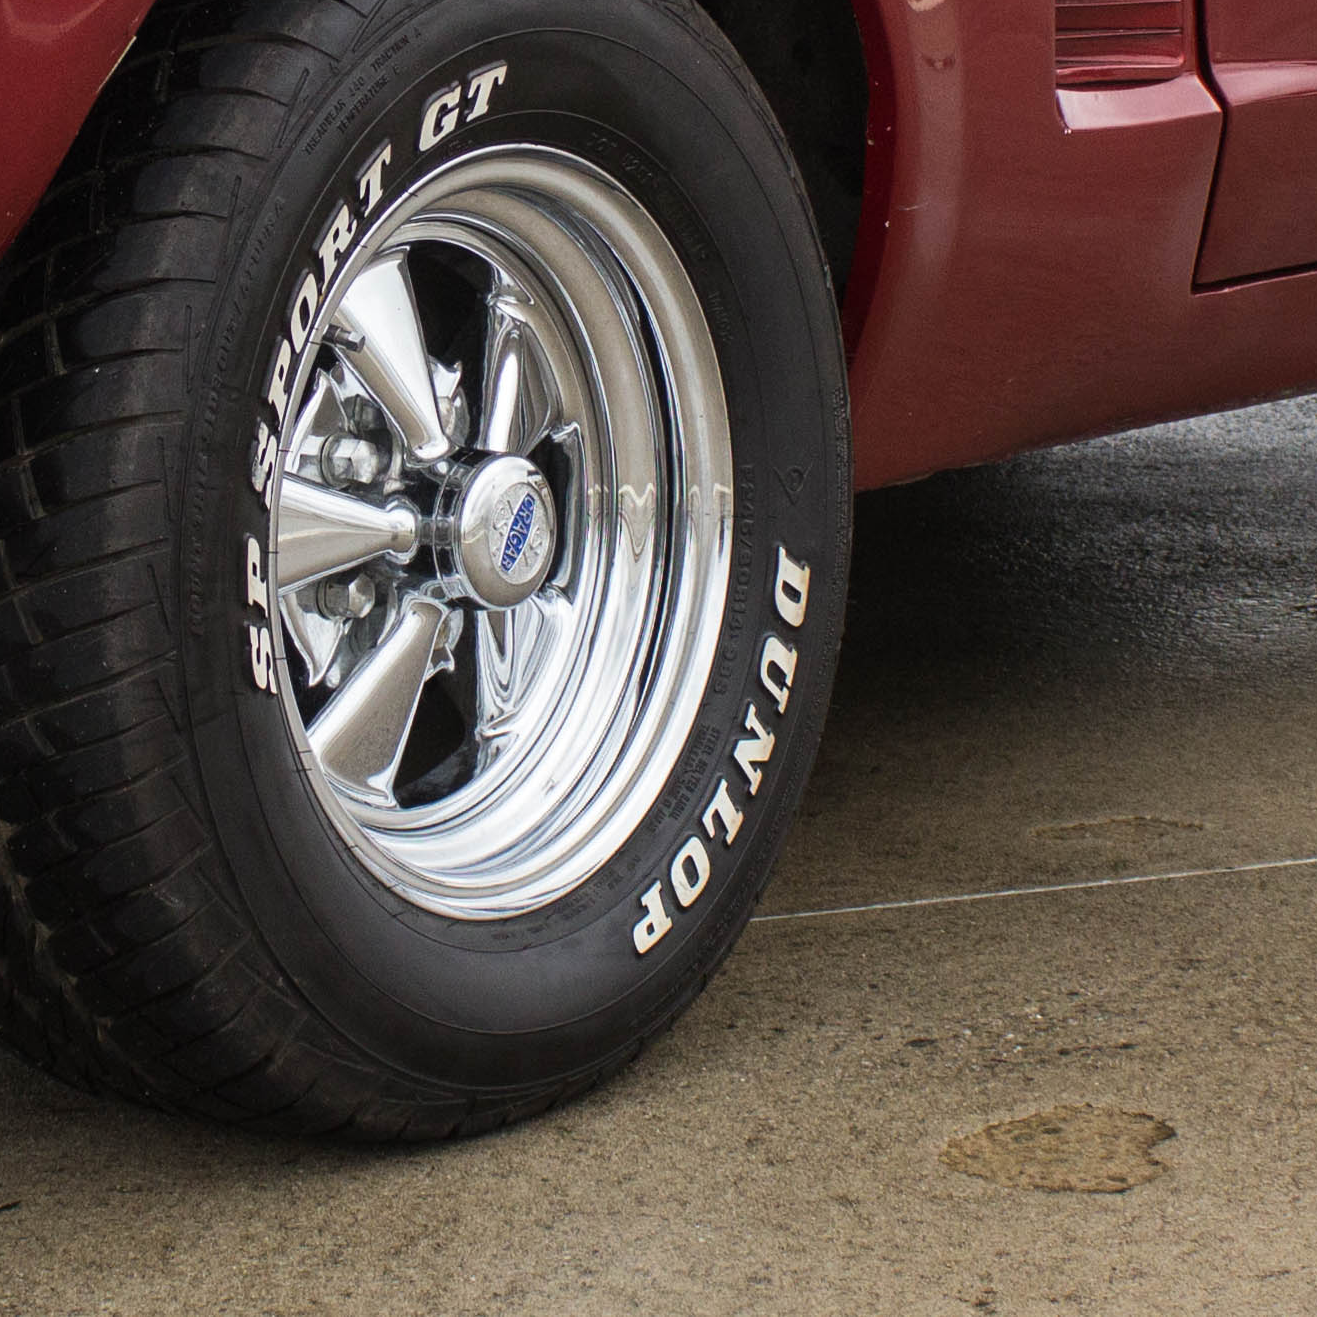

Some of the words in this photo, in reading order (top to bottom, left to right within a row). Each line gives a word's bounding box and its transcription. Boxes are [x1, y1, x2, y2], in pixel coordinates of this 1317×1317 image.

[419, 61, 507, 152] GT
[252, 141, 392, 511] SPORT
[500, 493, 536, 573] CRAGAR
[247, 537, 277, 694] SP
[633, 546, 810, 955] DUNLOP
